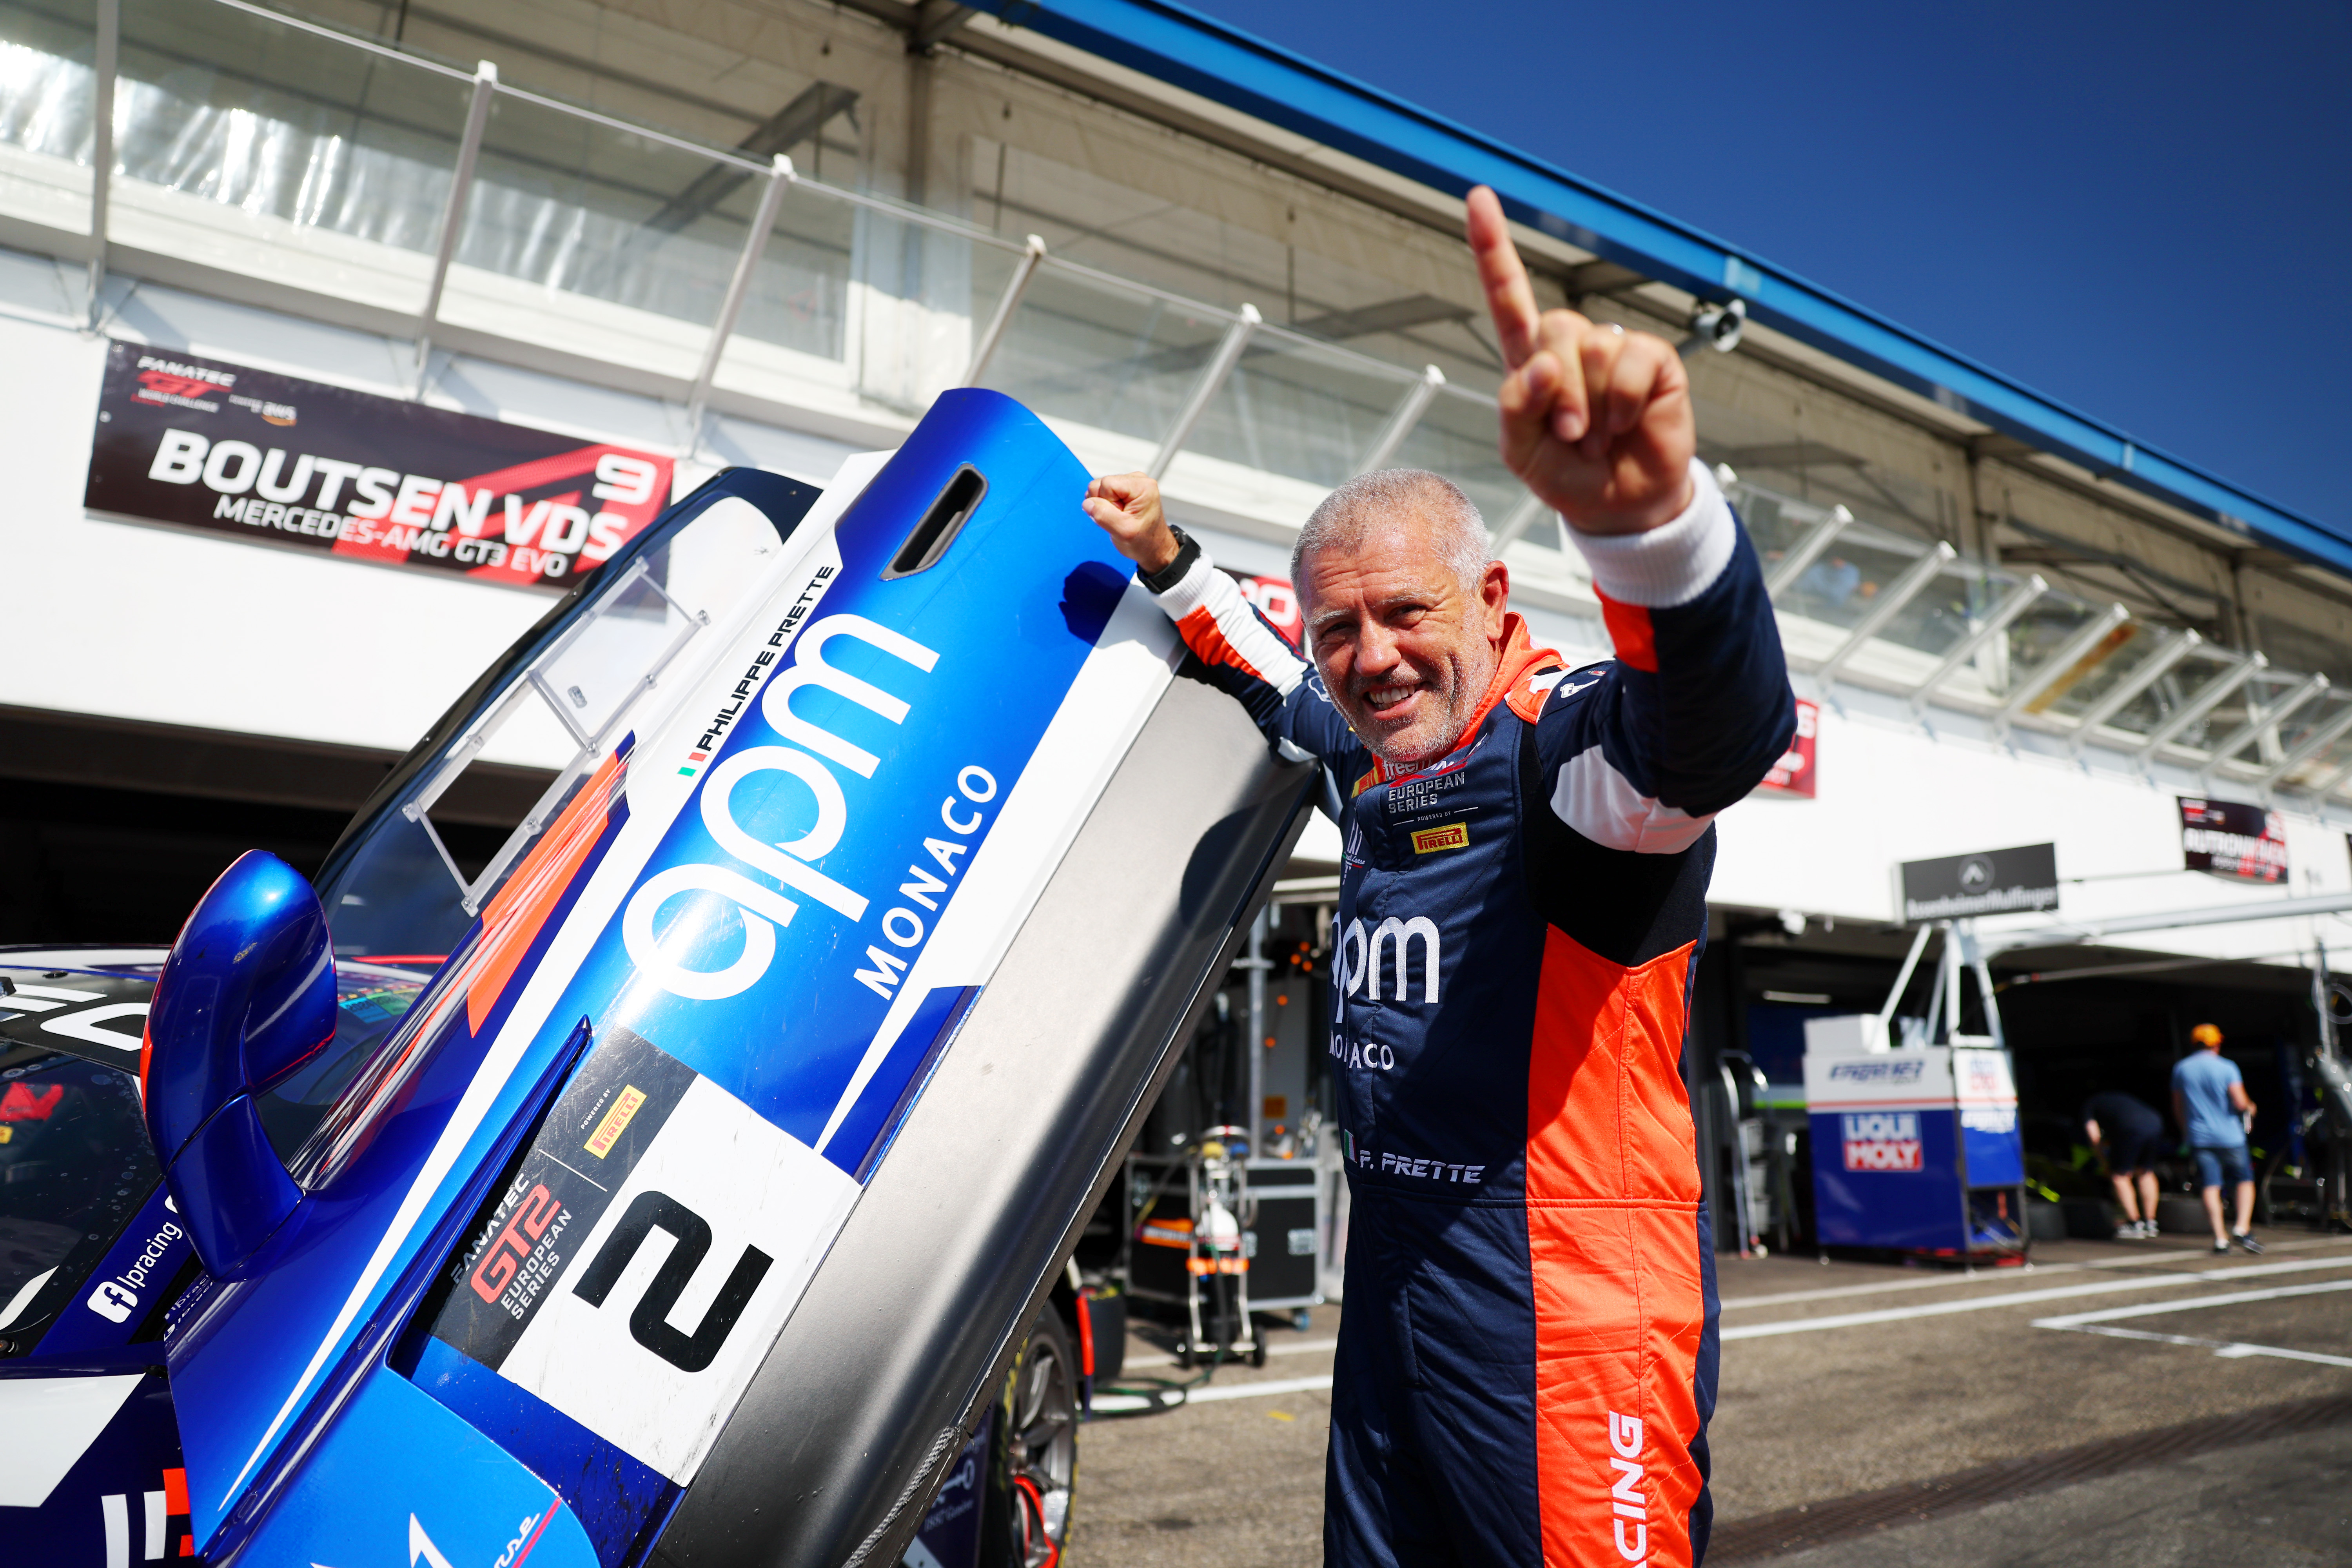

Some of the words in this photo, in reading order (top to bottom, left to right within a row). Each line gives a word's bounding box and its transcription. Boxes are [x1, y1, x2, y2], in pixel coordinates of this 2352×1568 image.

[137, 356, 236, 387] FANATEC
[262, 401, 297, 420] aws
[148, 428, 494, 537] BOUTSEN
[504, 494, 628, 561] VDS
[592, 453, 657, 505] 9
[213, 494, 452, 557] MERCEDES-AMG
[454, 537, 508, 567] GT3
[510, 547, 569, 577] EVO
[696, 651, 776, 751] PHILIPPE
[767, 566, 835, 647] PRETTE
[622, 613, 941, 1000] apm
[1388, 772, 1465, 802] EUROPEAN
[1388, 793, 1438, 814] SERIES
[1416, 828, 1463, 850] PIRELLI
[1417, 812, 1443, 822] POWERED
[853, 765, 997, 1000] MONACO
[580, 1098, 604, 1130] POWERED
[603, 1088, 611, 1098] BY
[591, 1093, 639, 1151] PIRELLI
[1381, 1152, 1486, 1183] PRETTE
[1847, 1142, 1920, 1169] MOLY
[450, 1173, 530, 1285] FANATEC
[470, 1184, 562, 1304] GT2
[500, 1209, 572, 1310] EUROPEAN
[511, 1251, 560, 1320] SERIES
[572, 1190, 774, 1373] 2
